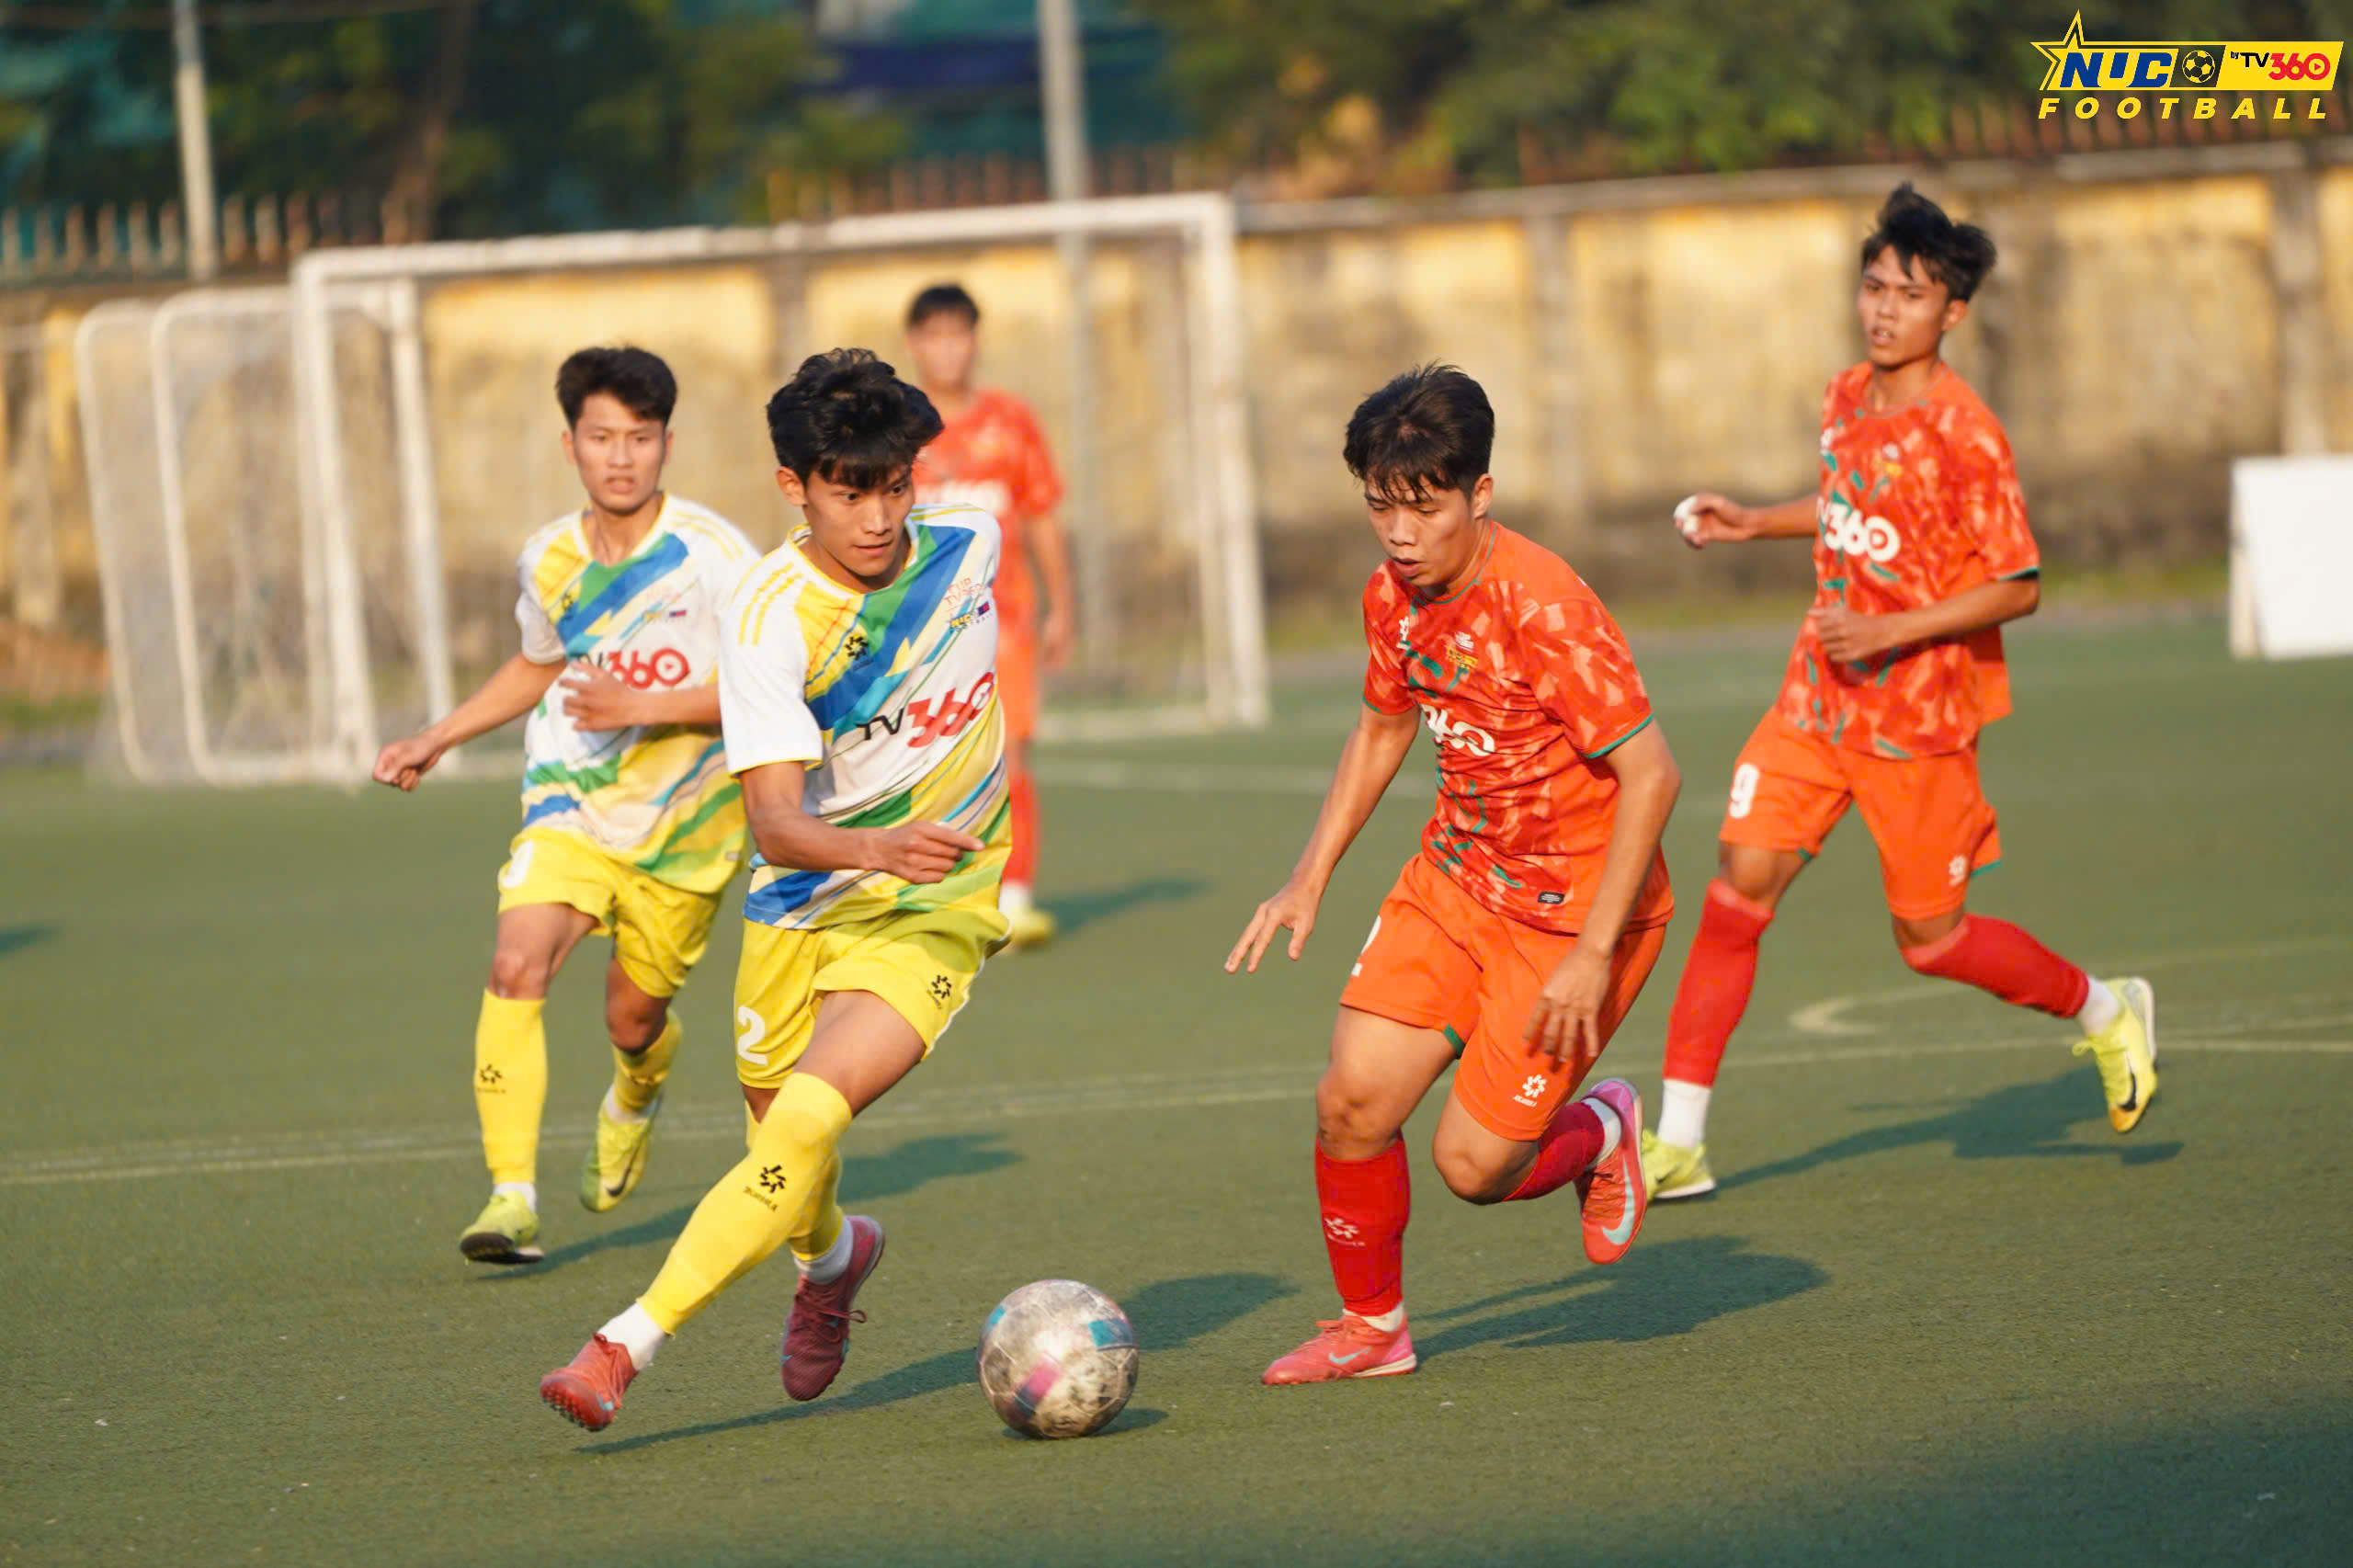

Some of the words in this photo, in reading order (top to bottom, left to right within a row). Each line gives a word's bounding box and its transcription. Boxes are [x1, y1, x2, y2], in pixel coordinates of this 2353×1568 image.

[856, 672, 994, 747] TV360
[1730, 762, 1761, 818] 9
[737, 1006, 768, 1067] 2
